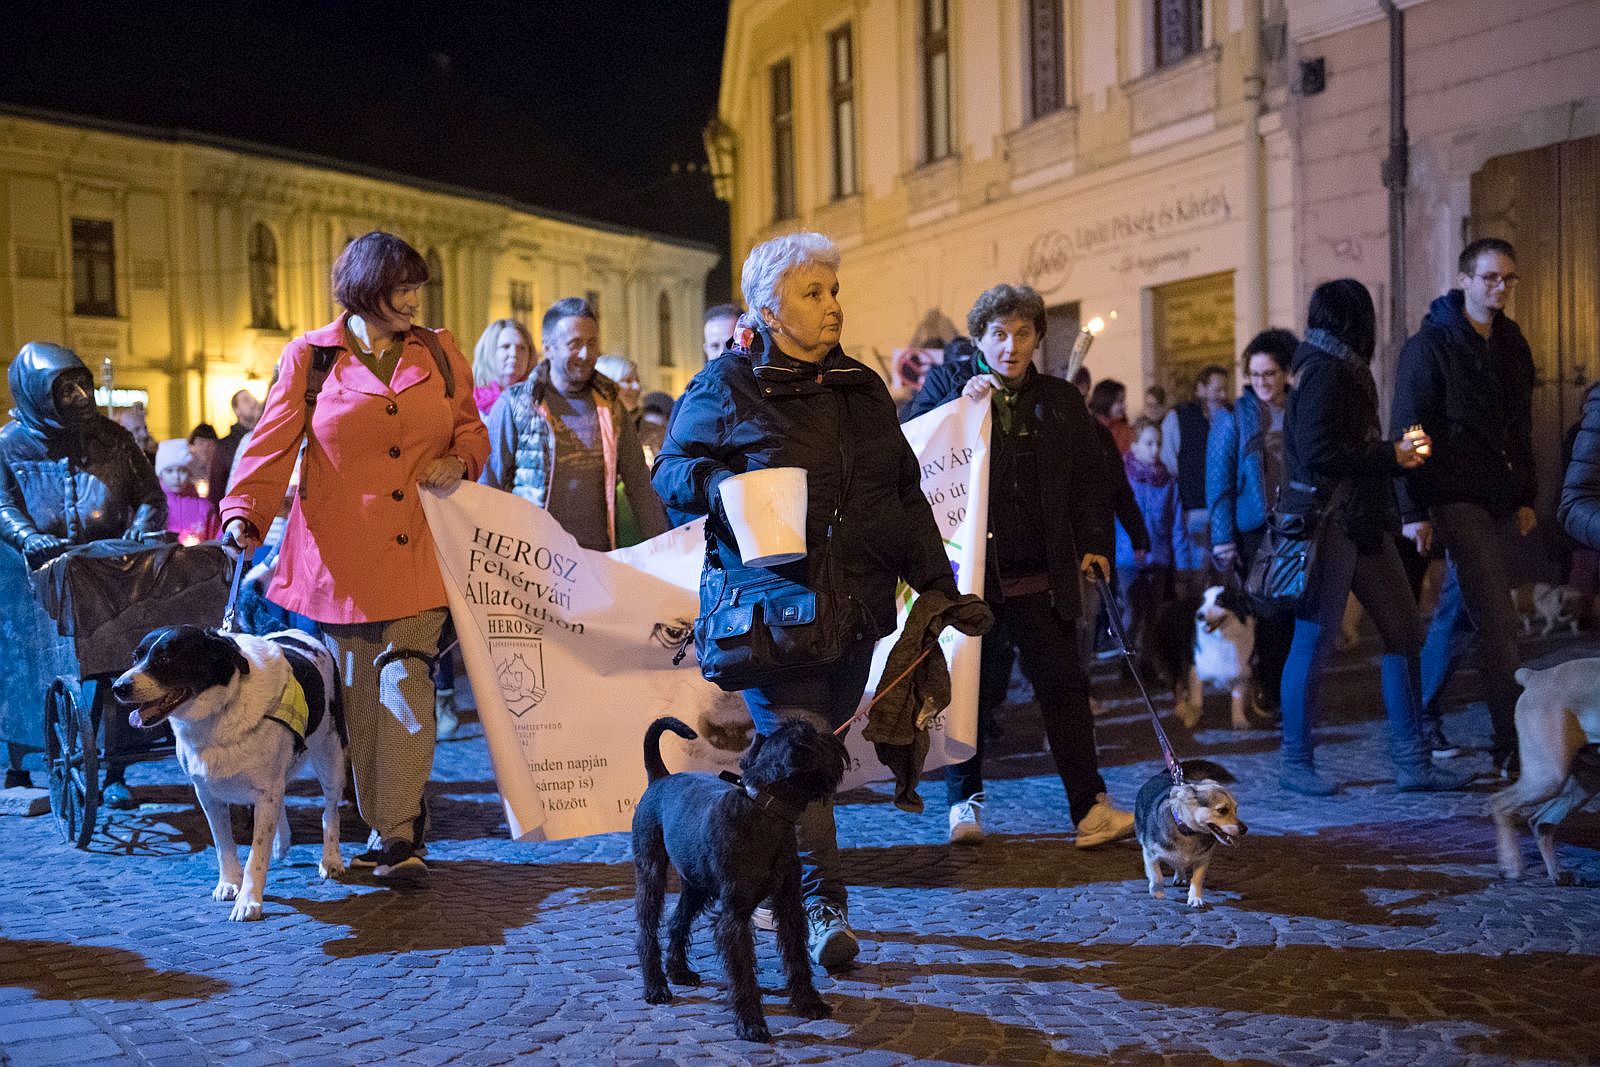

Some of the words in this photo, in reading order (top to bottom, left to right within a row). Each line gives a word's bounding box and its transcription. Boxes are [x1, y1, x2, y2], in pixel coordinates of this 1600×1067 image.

[921, 447, 973, 479] RVÁR
[949, 482, 967, 499] út
[473, 527, 578, 583] HEROSZ
[469, 550, 571, 610] Fehérvári
[465, 574, 585, 635] Állatotthon
[488, 619, 544, 636] HEROSZ
[940, 634, 954, 645] vár
[528, 758, 563, 772] inden
[567, 754, 608, 773] napján
[536, 778, 575, 793] sárnap
[578, 775, 594, 790] is)
[548, 798, 587, 812] között
